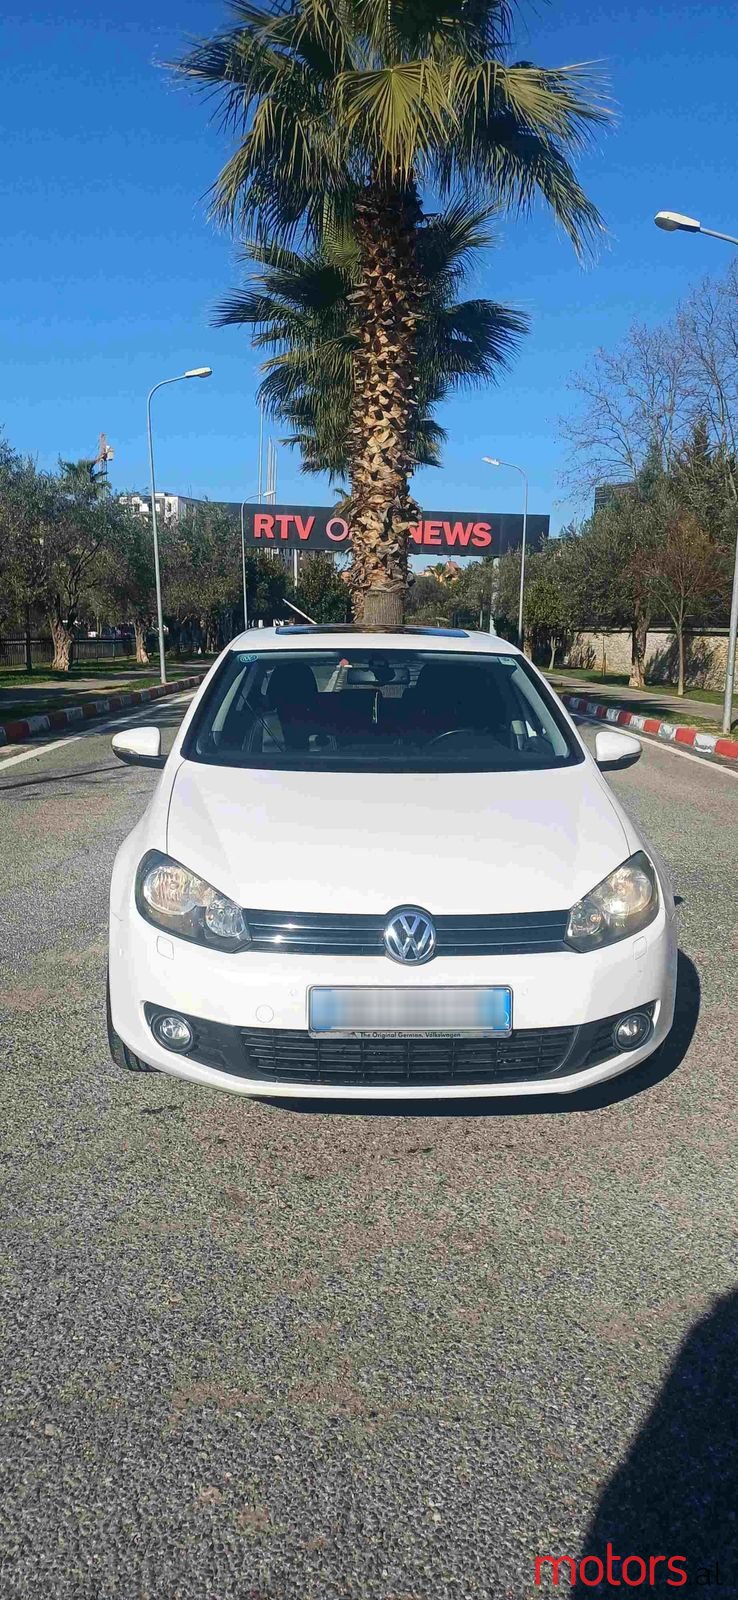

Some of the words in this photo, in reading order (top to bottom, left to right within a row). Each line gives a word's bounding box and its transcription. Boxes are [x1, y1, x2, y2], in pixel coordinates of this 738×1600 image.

[254, 514, 316, 540] RTV
[386, 911, 434, 962] VW
[373, 1031, 396, 1039] Original
